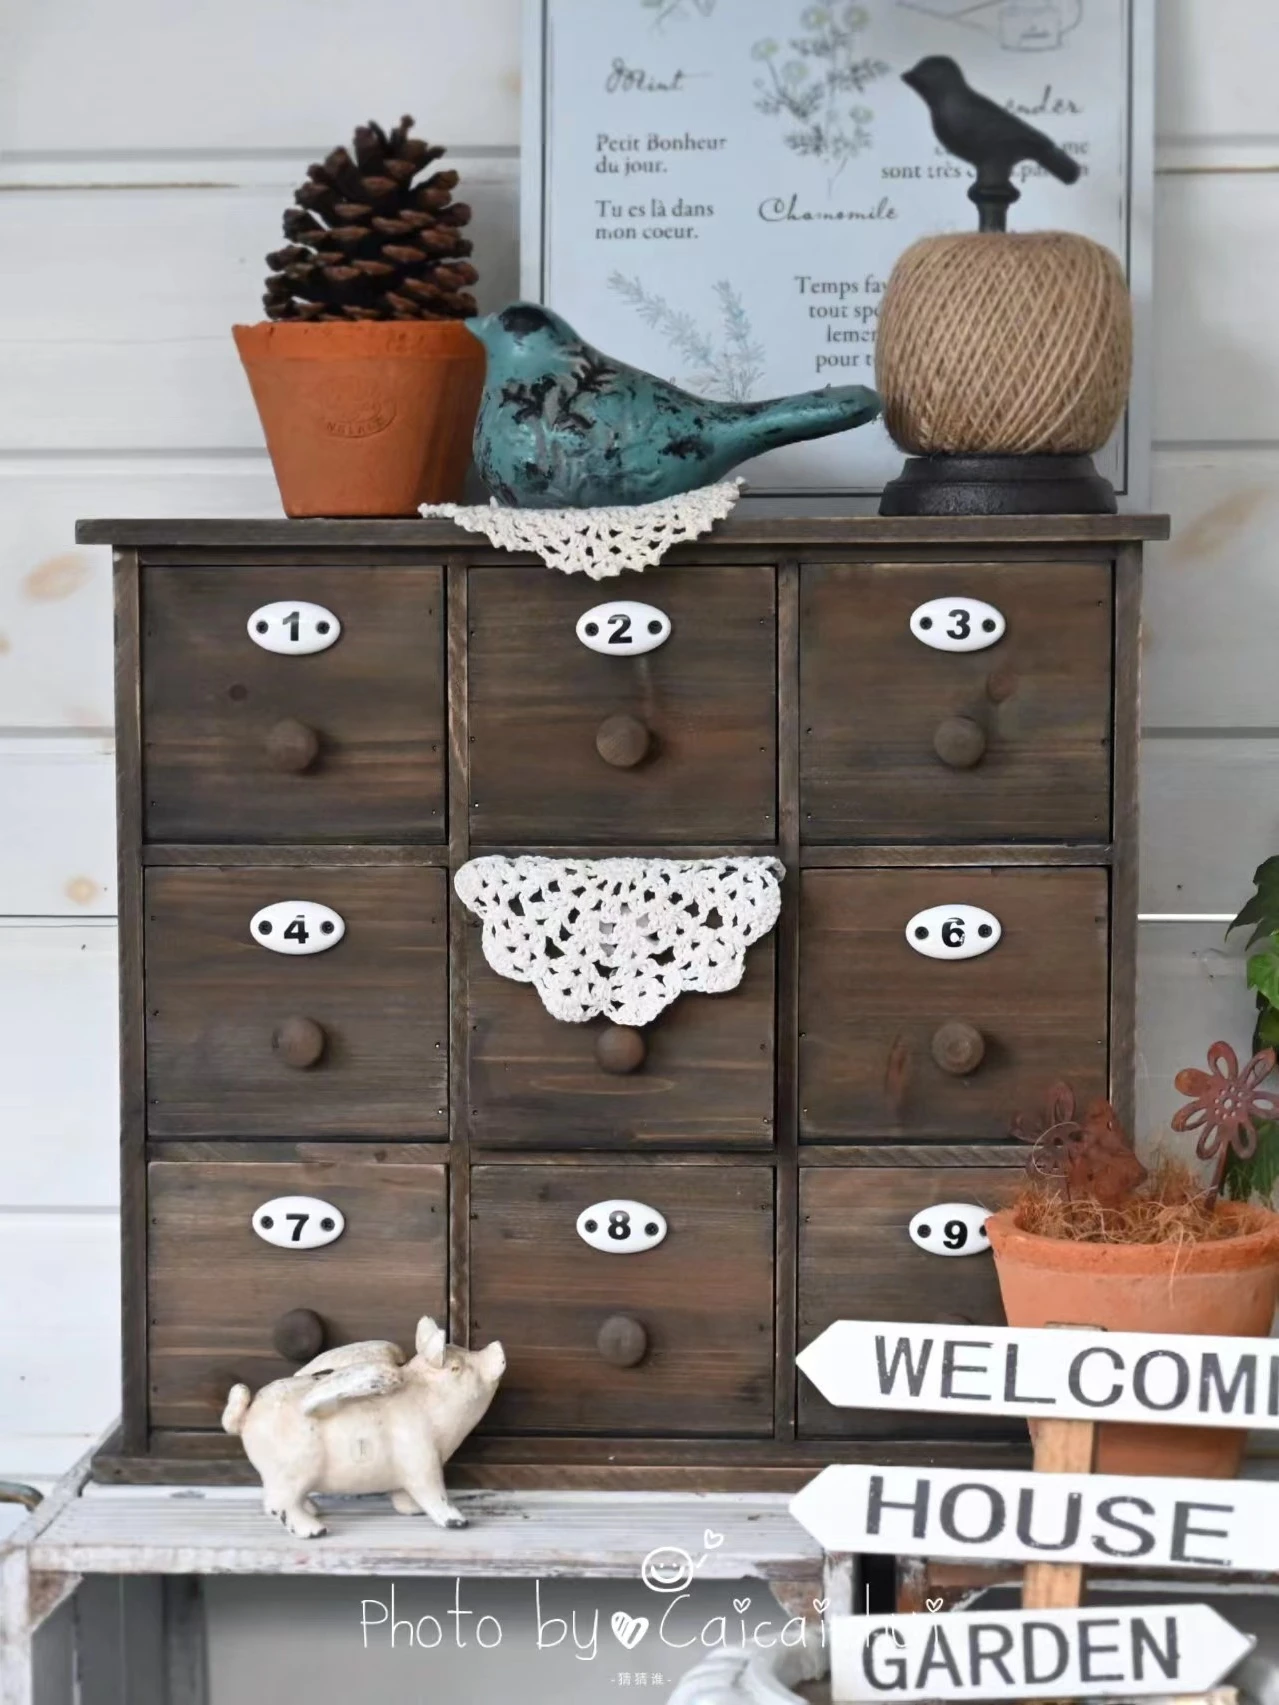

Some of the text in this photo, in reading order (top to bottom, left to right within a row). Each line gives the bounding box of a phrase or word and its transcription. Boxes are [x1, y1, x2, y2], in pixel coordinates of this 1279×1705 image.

[596, 132, 727, 151] Petit Bonheur
[595, 155, 668, 176] du jour.
[881, 164, 926, 179] sont
[595, 197, 715, 218] Tu es là dans
[758, 193, 899, 222] Chamomile
[595, 226, 699, 240] mon coeur.
[794, 275, 859, 300] Temps
[808, 304, 848, 319] tout
[815, 351, 860, 373] pour
[282, 611, 300, 642] 1
[608, 613, 633, 644] 2
[946, 609, 971, 640] 3
[283, 914, 309, 944] 4
[941, 917, 965, 948] 6
[285, 1213, 309, 1242] 7
[607, 1210, 631, 1240] 8
[943, 1220, 968, 1250] 9
[866, 1475, 1235, 1566] HOUSE
[862, 1616, 1180, 1691] GARDEN
